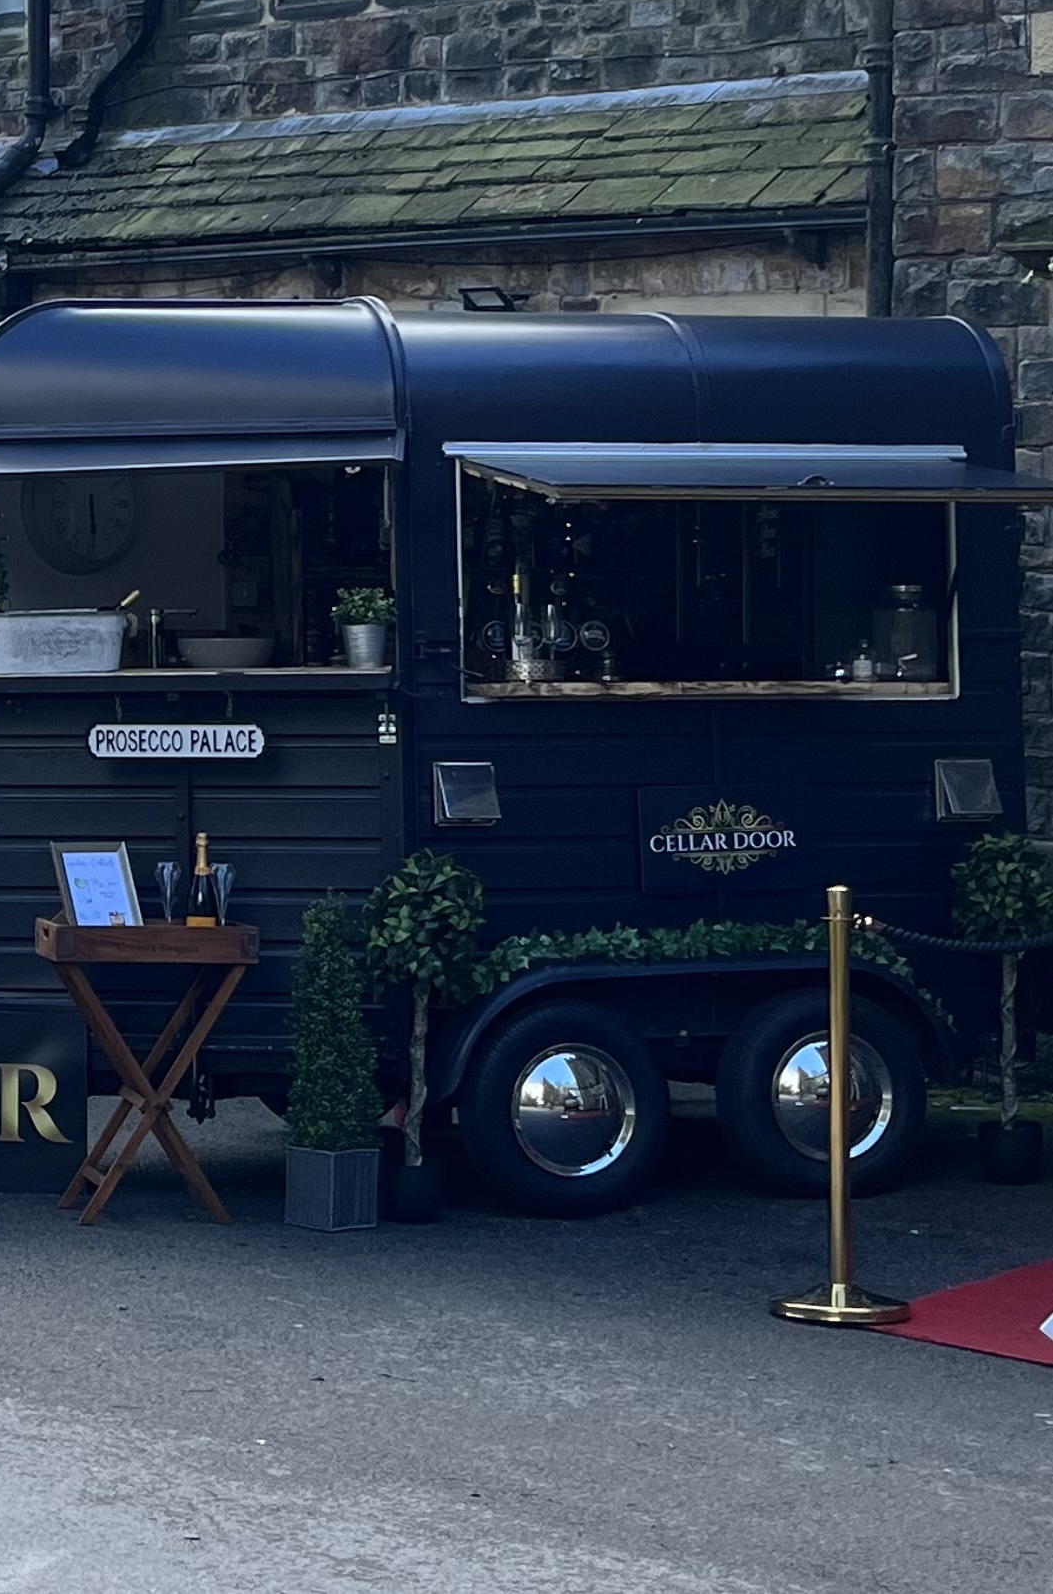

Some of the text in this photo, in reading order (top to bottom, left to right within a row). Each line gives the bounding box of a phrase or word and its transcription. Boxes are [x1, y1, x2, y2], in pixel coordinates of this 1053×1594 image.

[95, 729, 257, 752] PROSECCO PALACE
[649, 830, 797, 852] CELLAR DOOR
